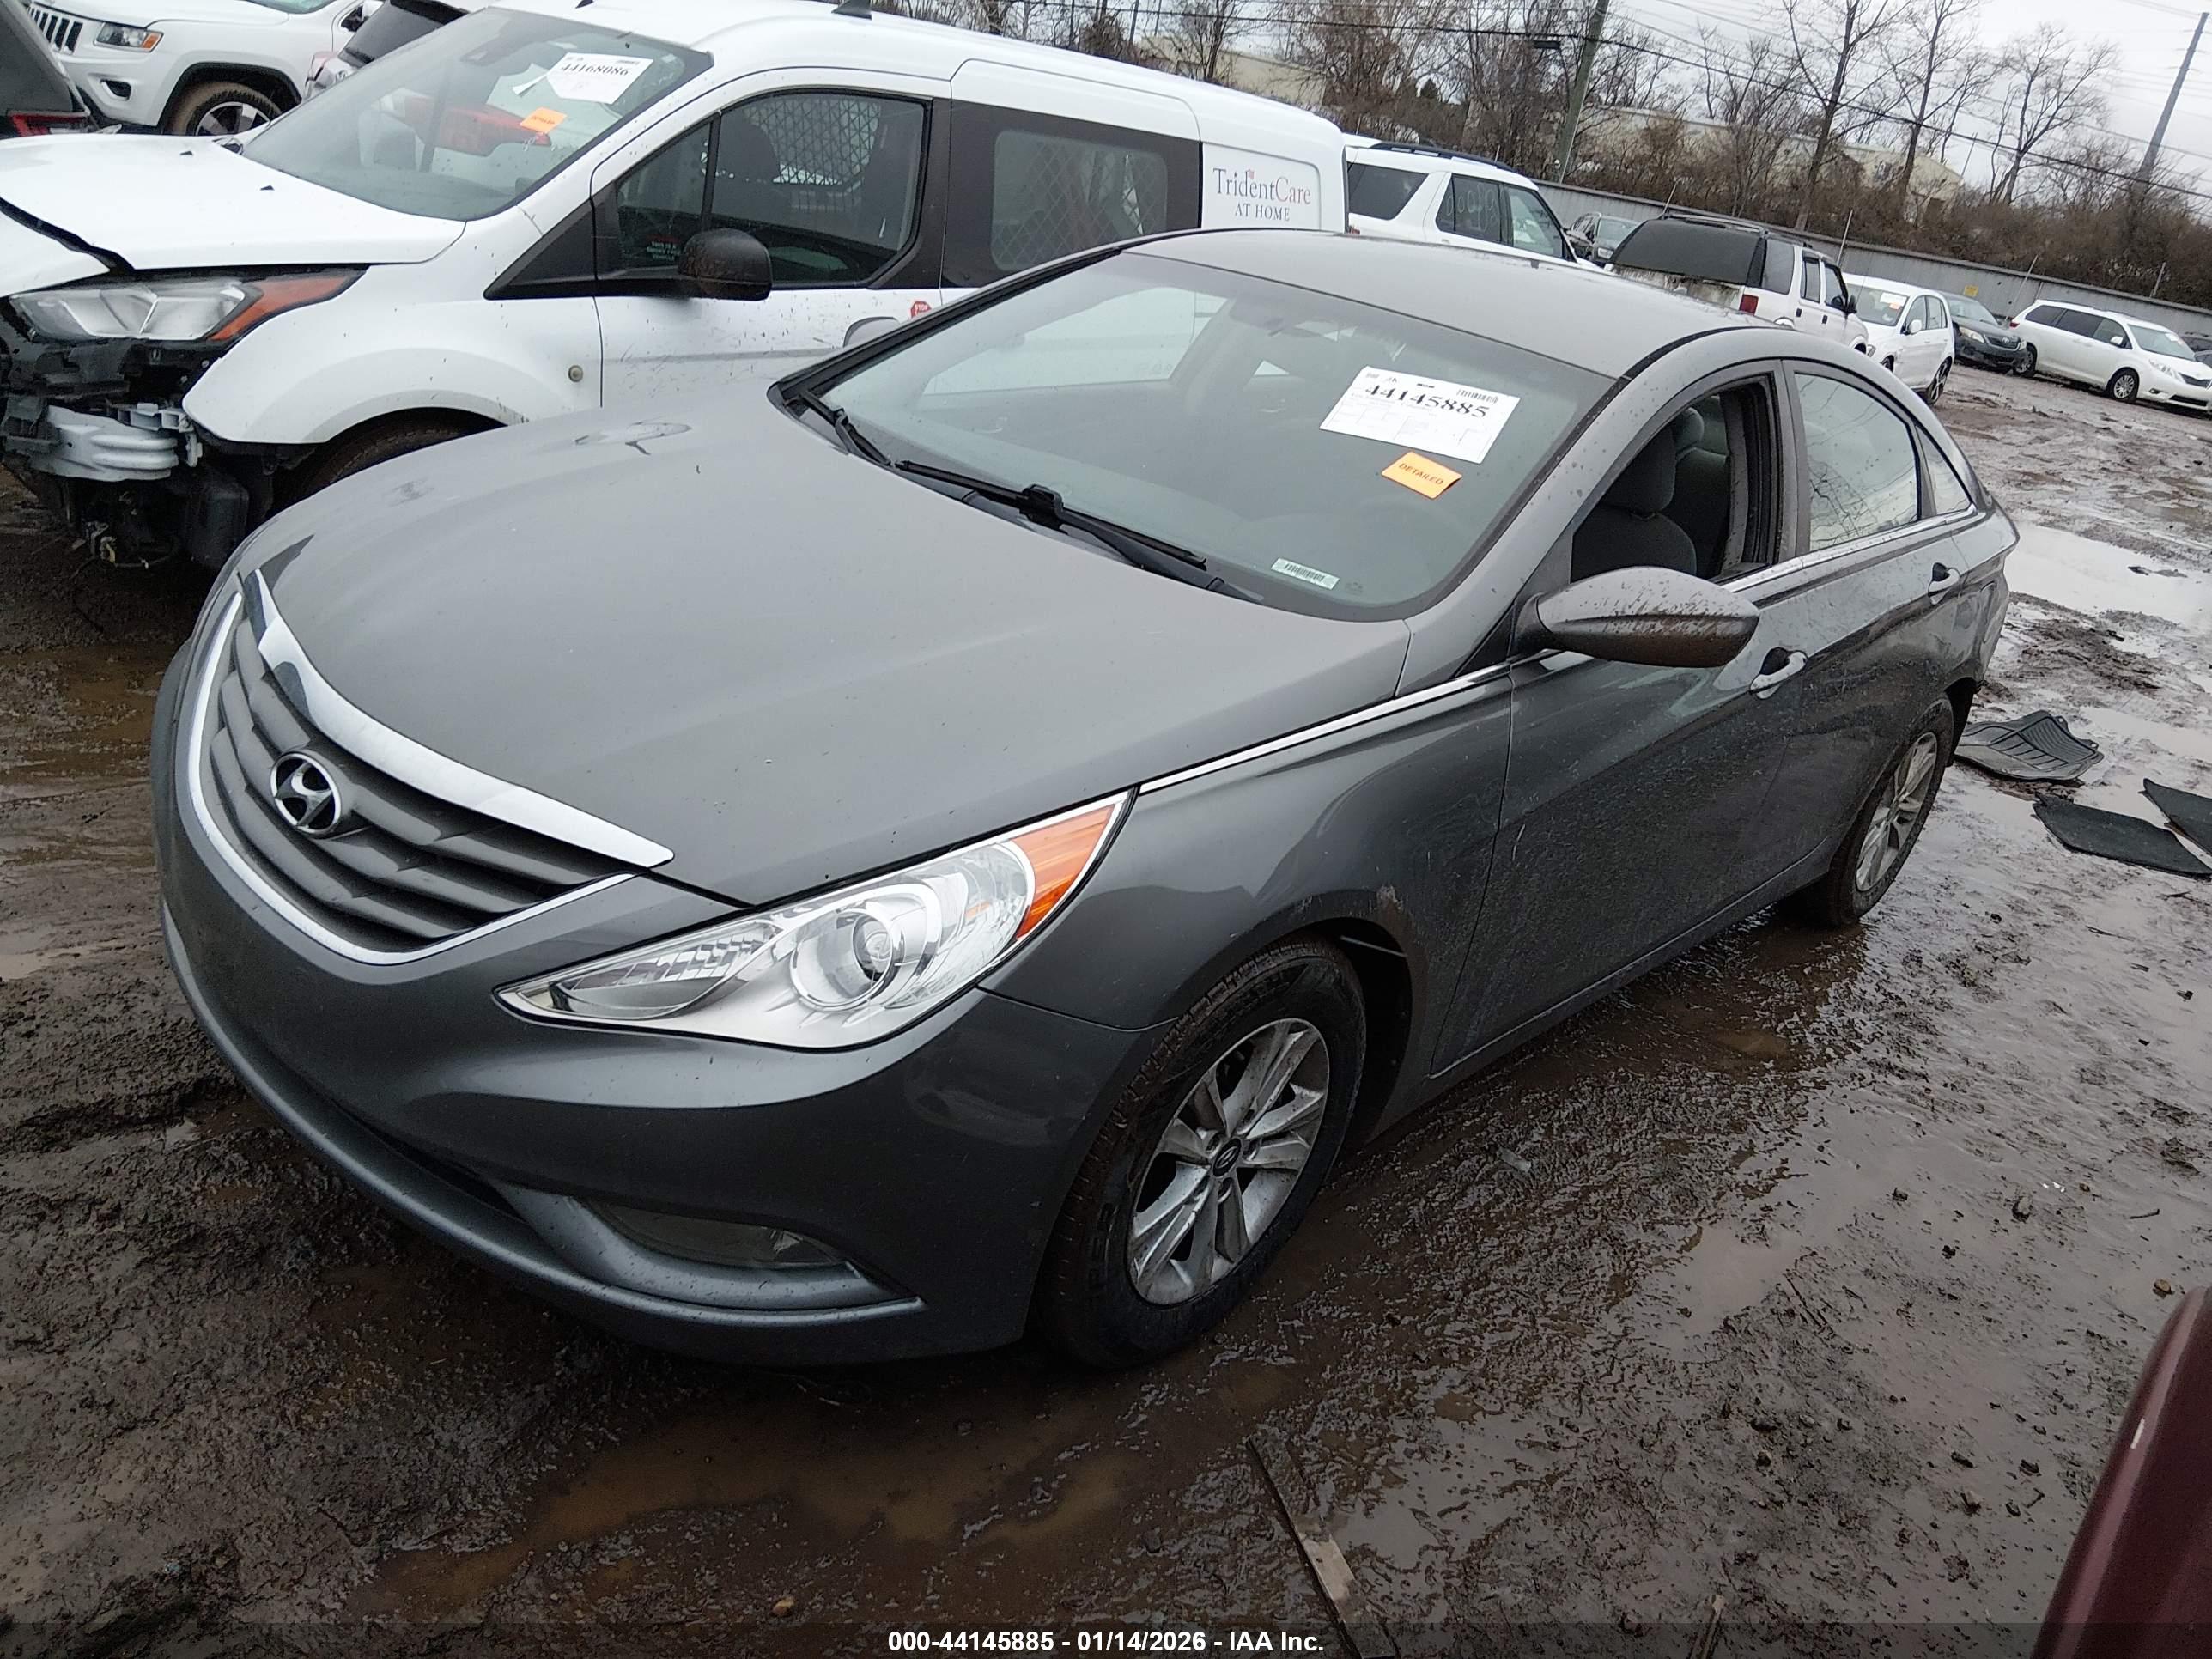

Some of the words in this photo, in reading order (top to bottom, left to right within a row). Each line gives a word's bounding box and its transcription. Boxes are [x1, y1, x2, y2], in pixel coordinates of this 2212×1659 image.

[561, 64, 629, 76] 44168086
[1212, 167, 1311, 205] TridentCare
[1235, 203, 1251, 216] AT
[1255, 204, 1290, 222] HOME
[1365, 385, 1490, 418] 44145885
[1398, 463, 1443, 485] DETAILED
